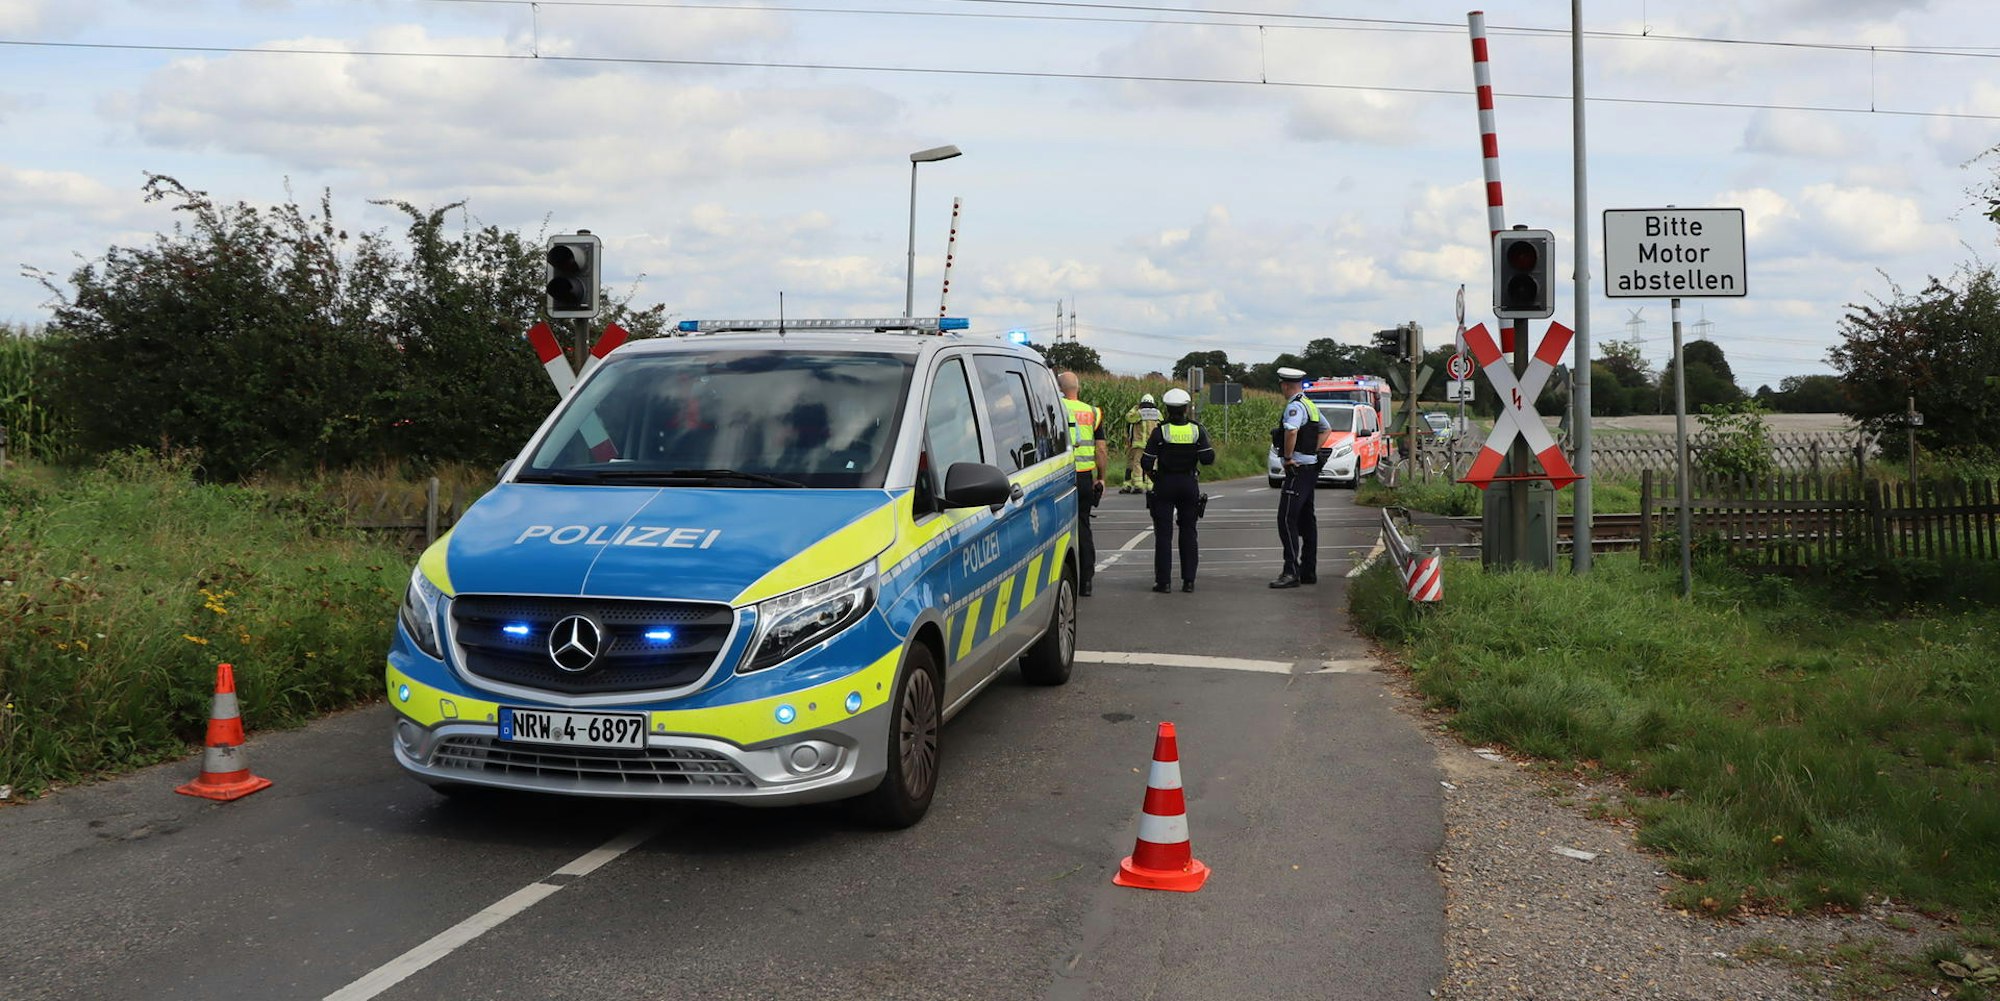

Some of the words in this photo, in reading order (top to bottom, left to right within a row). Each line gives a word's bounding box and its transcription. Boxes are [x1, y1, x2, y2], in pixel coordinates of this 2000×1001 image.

[1646, 216, 1702, 236] Bitte
[1639, 243, 1710, 263] Motor
[1618, 269, 1734, 290] abstellen
[514, 525, 722, 549] POLIZEI
[963, 530, 1000, 578] POLIZEI
[513, 712, 550, 739] NRW
[564, 716, 641, 744] 4-6897
